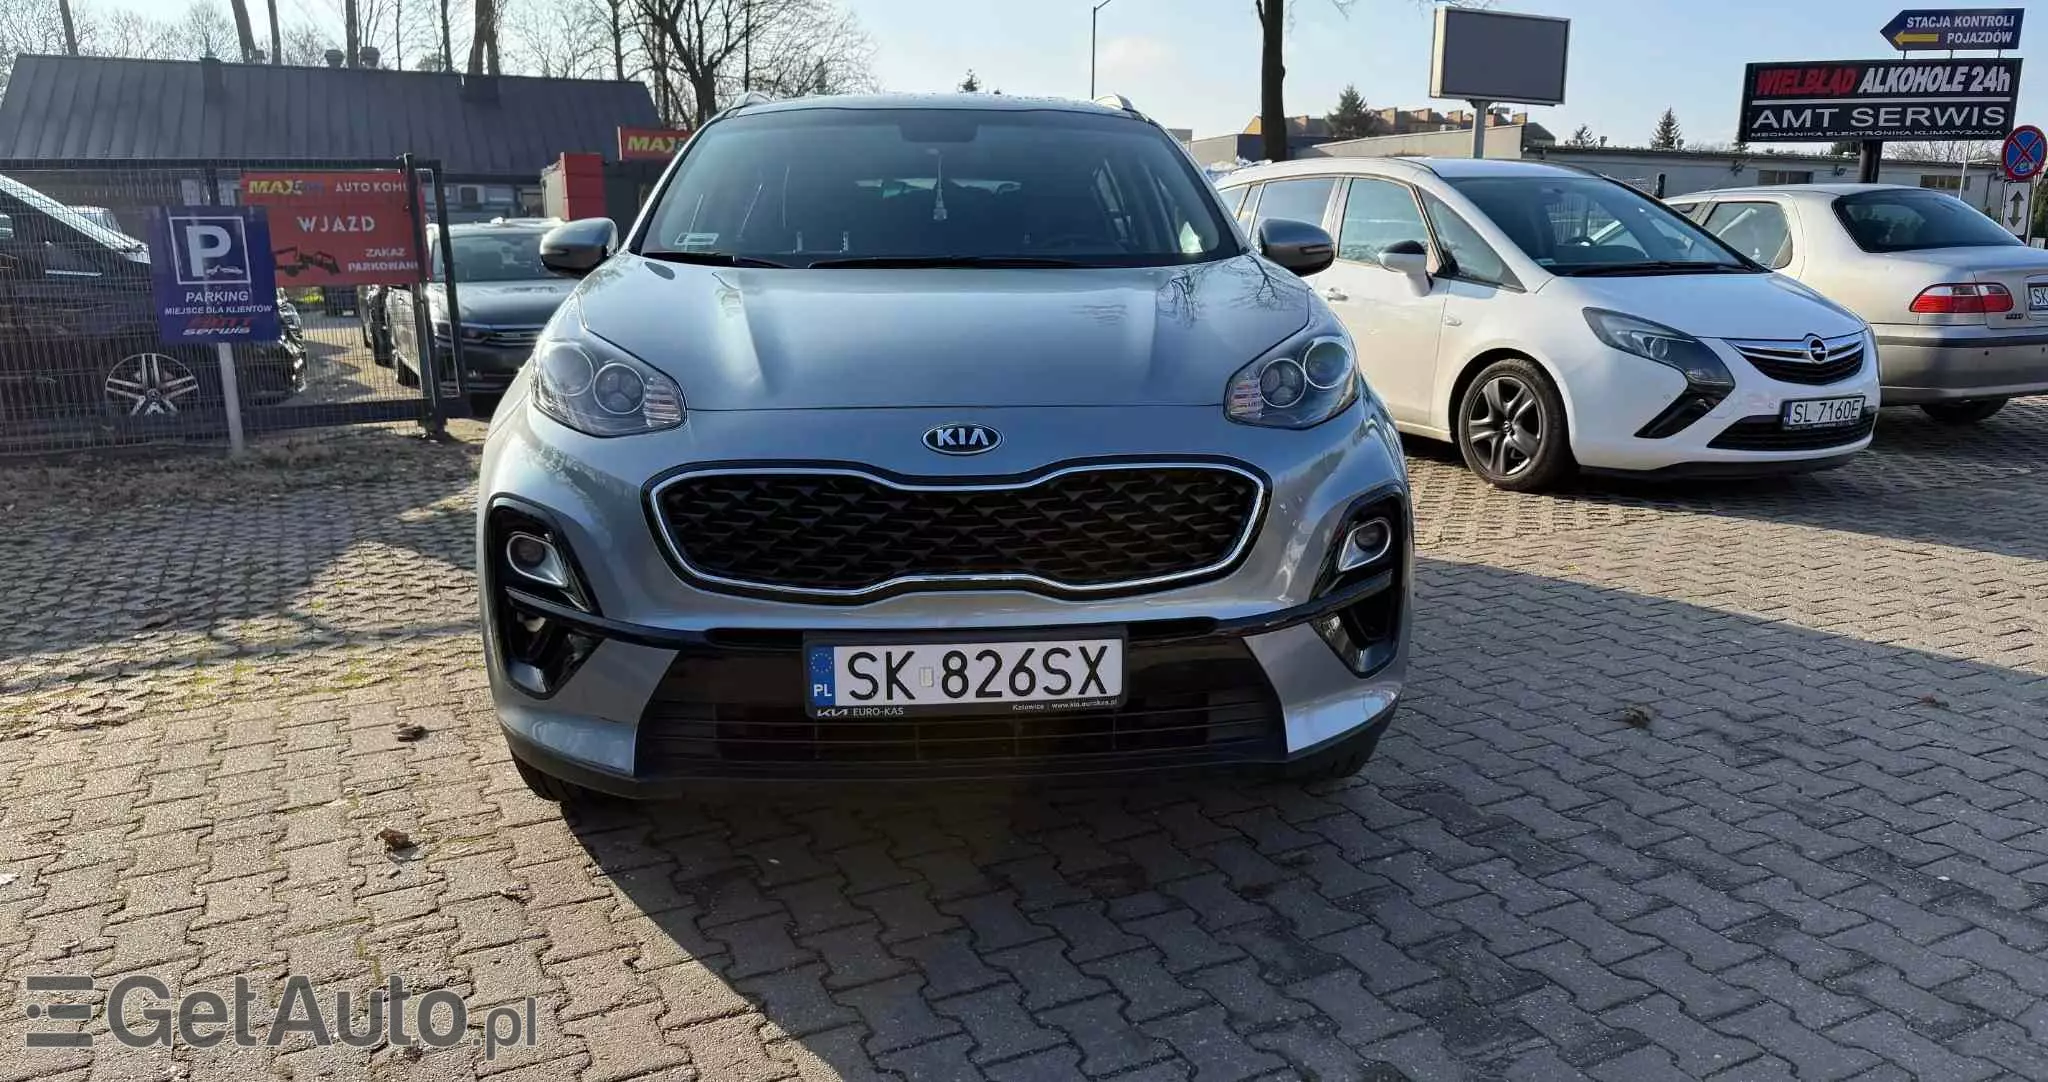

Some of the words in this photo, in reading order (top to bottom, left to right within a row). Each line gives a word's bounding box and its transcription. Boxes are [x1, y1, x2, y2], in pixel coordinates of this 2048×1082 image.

[1906, 16, 1951, 28] STACJA
[1954, 15, 2015, 28] KONTROLI
[1946, 29, 2013, 44] POJAZDÓW
[1857, 66, 1968, 93] ALKOHOLE
[1968, 66, 2011, 92] 24h
[1751, 108, 1840, 129] AMT
[1850, 106, 2006, 128] SERWIS
[335, 182, 370, 193] AUTO
[298, 215, 376, 232] WJAZD
[185, 224, 232, 277] P
[365, 246, 407, 258] ZAKAZ
[348, 260, 419, 272] PARKOWANI
[185, 290, 249, 303] PARKING
[164, 306, 205, 316] MIEJSCE
[206, 306, 224, 314] DLA
[1793, 403, 1812, 423] SL
[1818, 399, 1860, 421] 7160E
[936, 427, 989, 447] KIA
[847, 650, 917, 701] SK
[941, 645, 1108, 699] 826SX
[813, 683, 833, 697] PL
